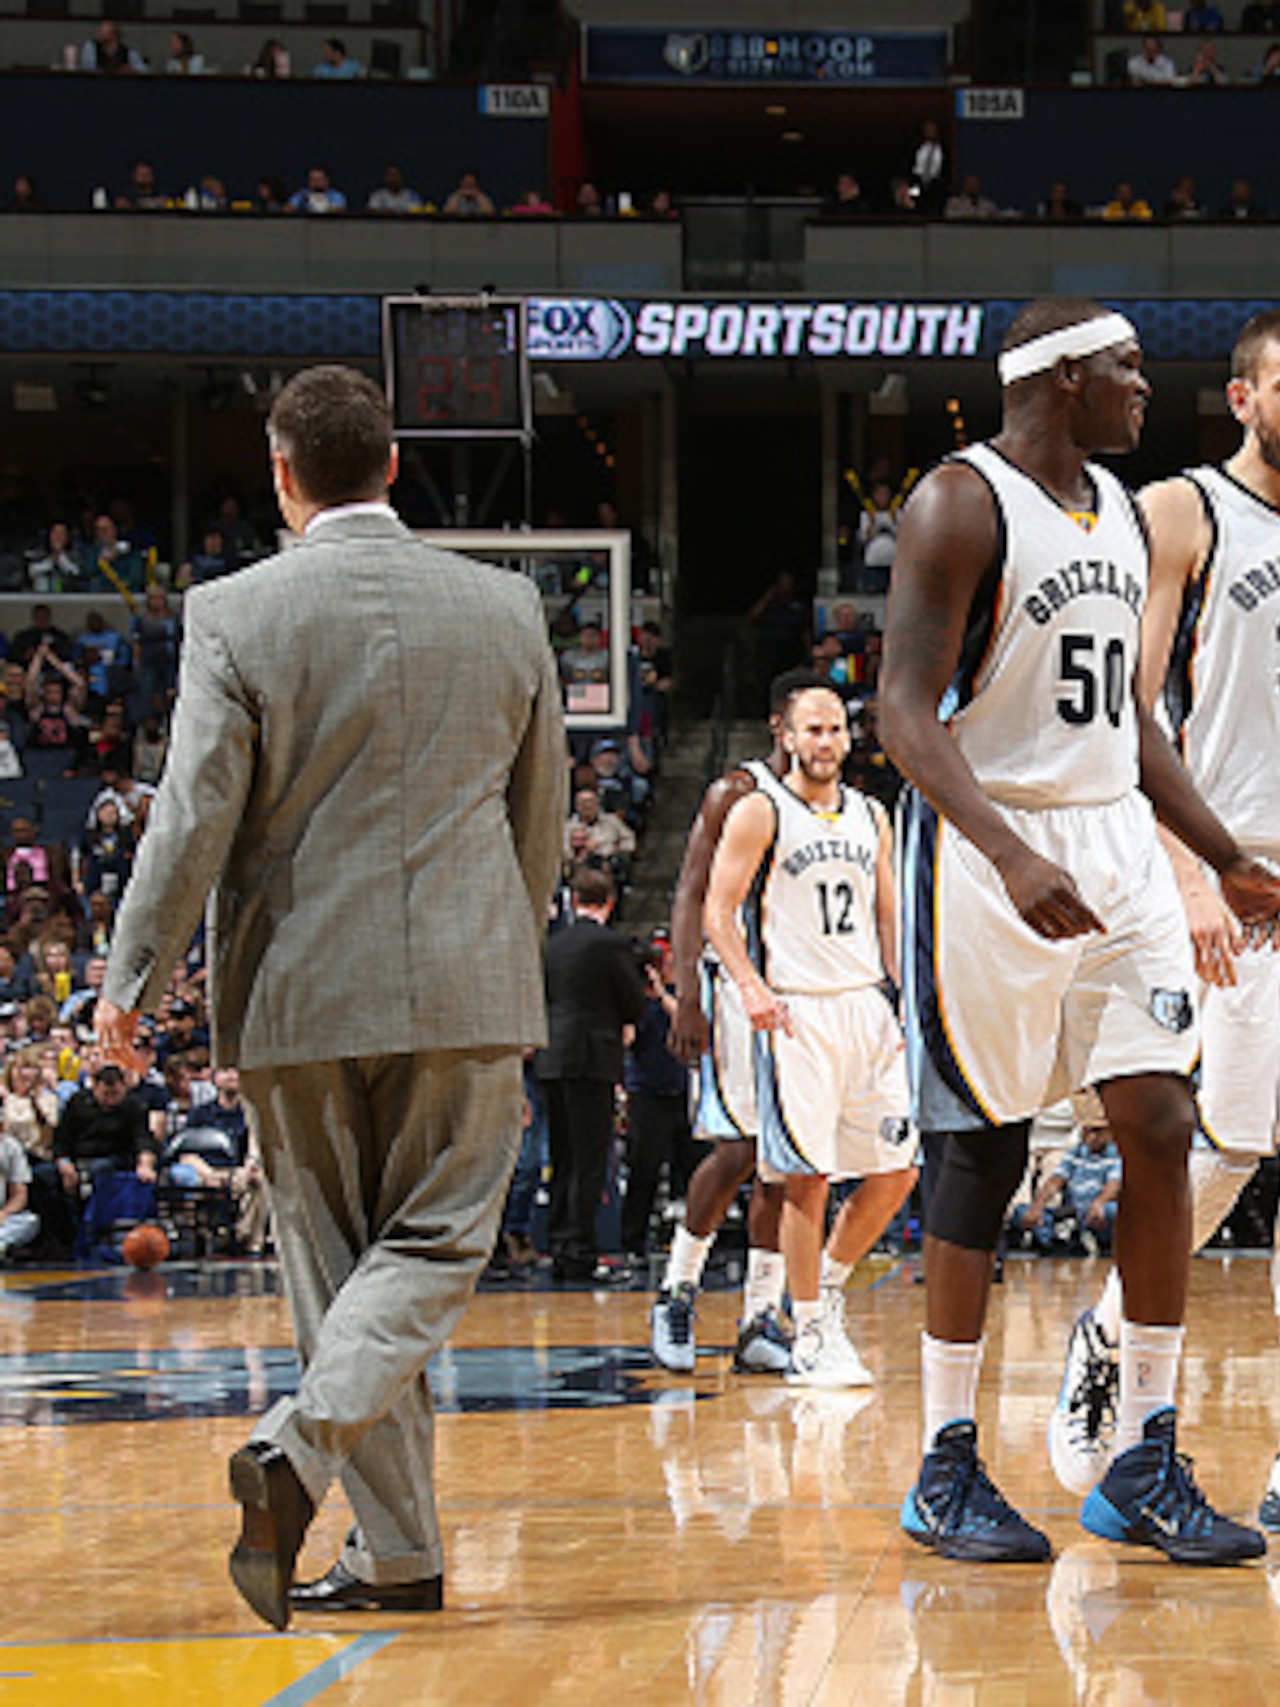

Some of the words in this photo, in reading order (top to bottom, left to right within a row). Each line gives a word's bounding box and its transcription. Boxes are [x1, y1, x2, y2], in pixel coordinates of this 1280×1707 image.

[634, 303, 983, 356] SPORTSOUTH
[1056, 633, 1125, 729] 50
[815, 880, 855, 935] 12
